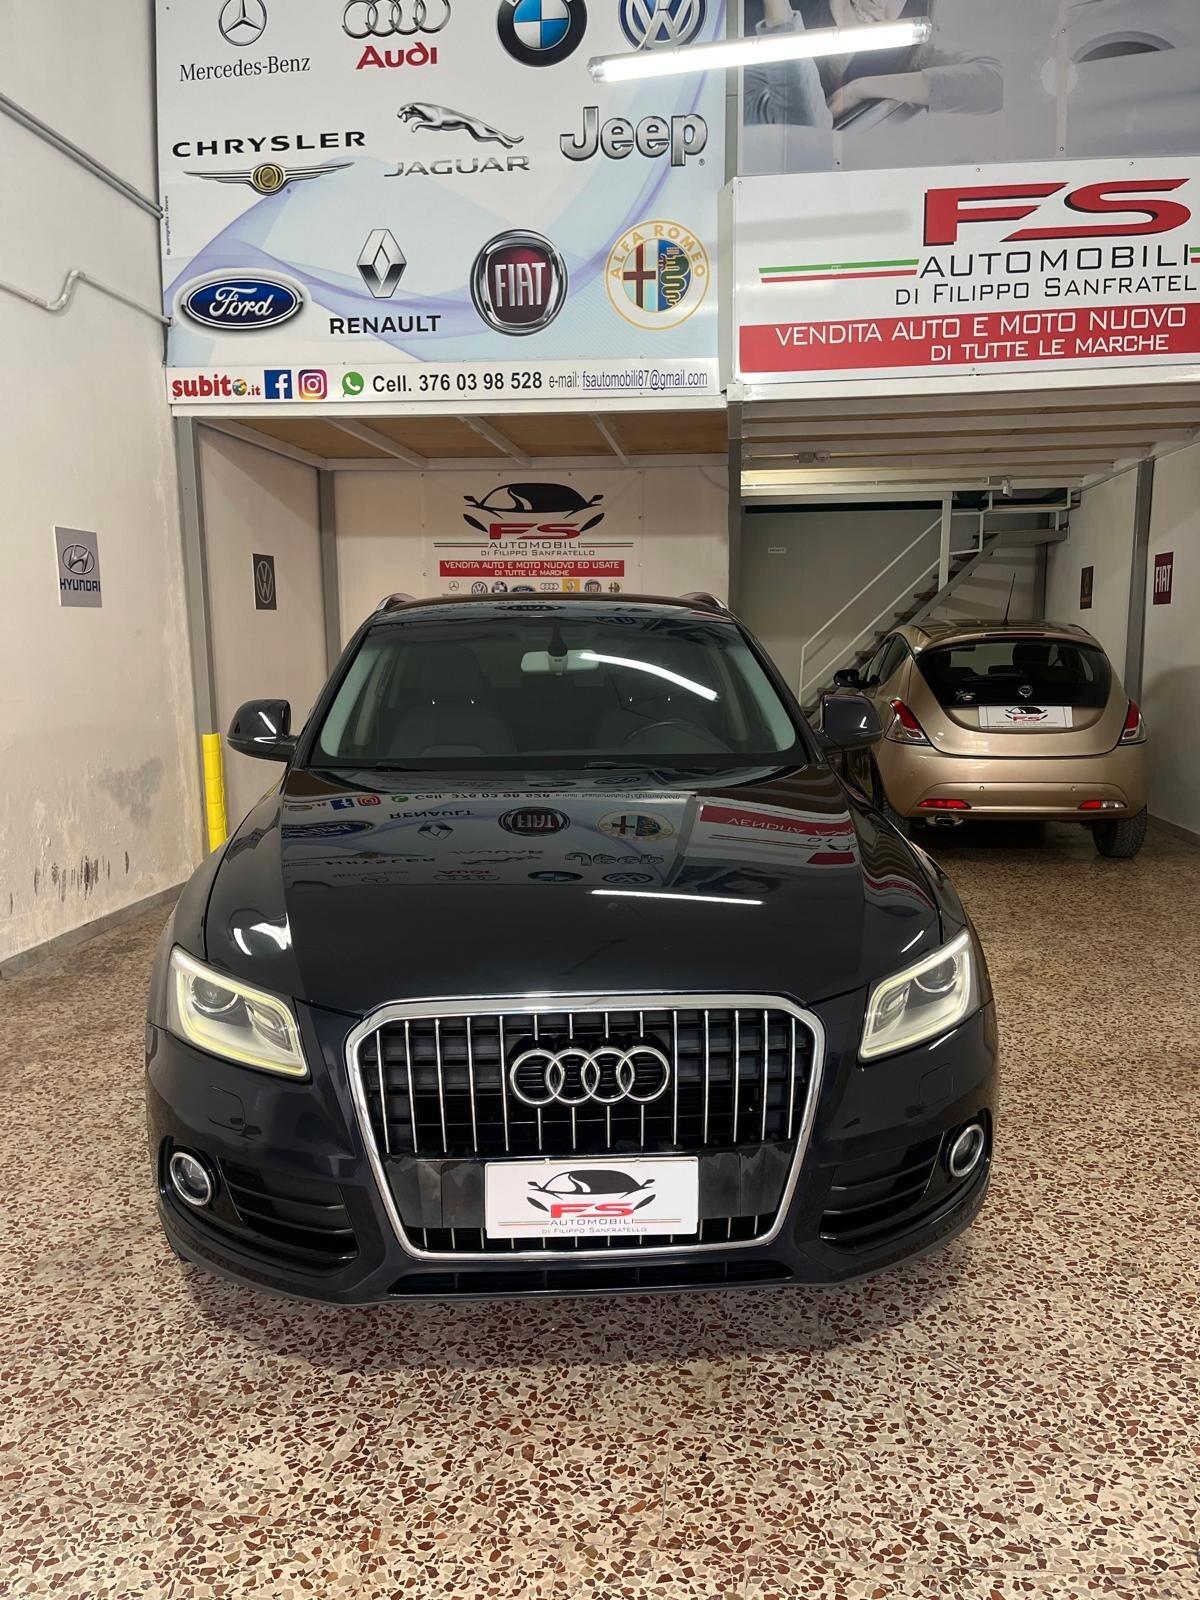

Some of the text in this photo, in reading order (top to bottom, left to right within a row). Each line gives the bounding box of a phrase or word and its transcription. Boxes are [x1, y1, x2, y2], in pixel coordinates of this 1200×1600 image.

[179, 55, 311, 81] Mercedes-Benz
[355, 42, 438, 70] Audi
[171, 131, 366, 158] CHRYSLER
[560, 106, 708, 167] Jeep
[383, 155, 531, 178] JAGUAR
[923, 178, 1192, 247] FS
[609, 224, 706, 280] ALFA ROMEO
[919, 244, 1189, 279] AUTOMOBILI
[495, 262, 546, 308] FIAT
[895, 288, 918, 306] DI
[933, 282, 1030, 304] FILIPPO
[208, 286, 274, 317] Ford
[329, 315, 442, 335] RENAULT
[775, 307, 1186, 347] VENDITA AUTO E MOTO NUOVO
[930, 333, 1170, 361] DI TUTTE LE MARCHE
[372, 369, 708, 393] Cell. 376 03 98 528 e-mail: fsautomobili87@gmail.com
[489, 523, 581, 540] FS
[489, 541, 581, 549] AUTOMOBILI
[444, 561, 620, 569] VENDITA AUTO E MOTO NUOVO ED USATE
[59, 577, 101, 592] HYUNDAI
[1154, 564, 1172, 593] FIAT
[549, 1218, 635, 1226] AUTOMOBILI
[550, 1202, 634, 1219] FS
